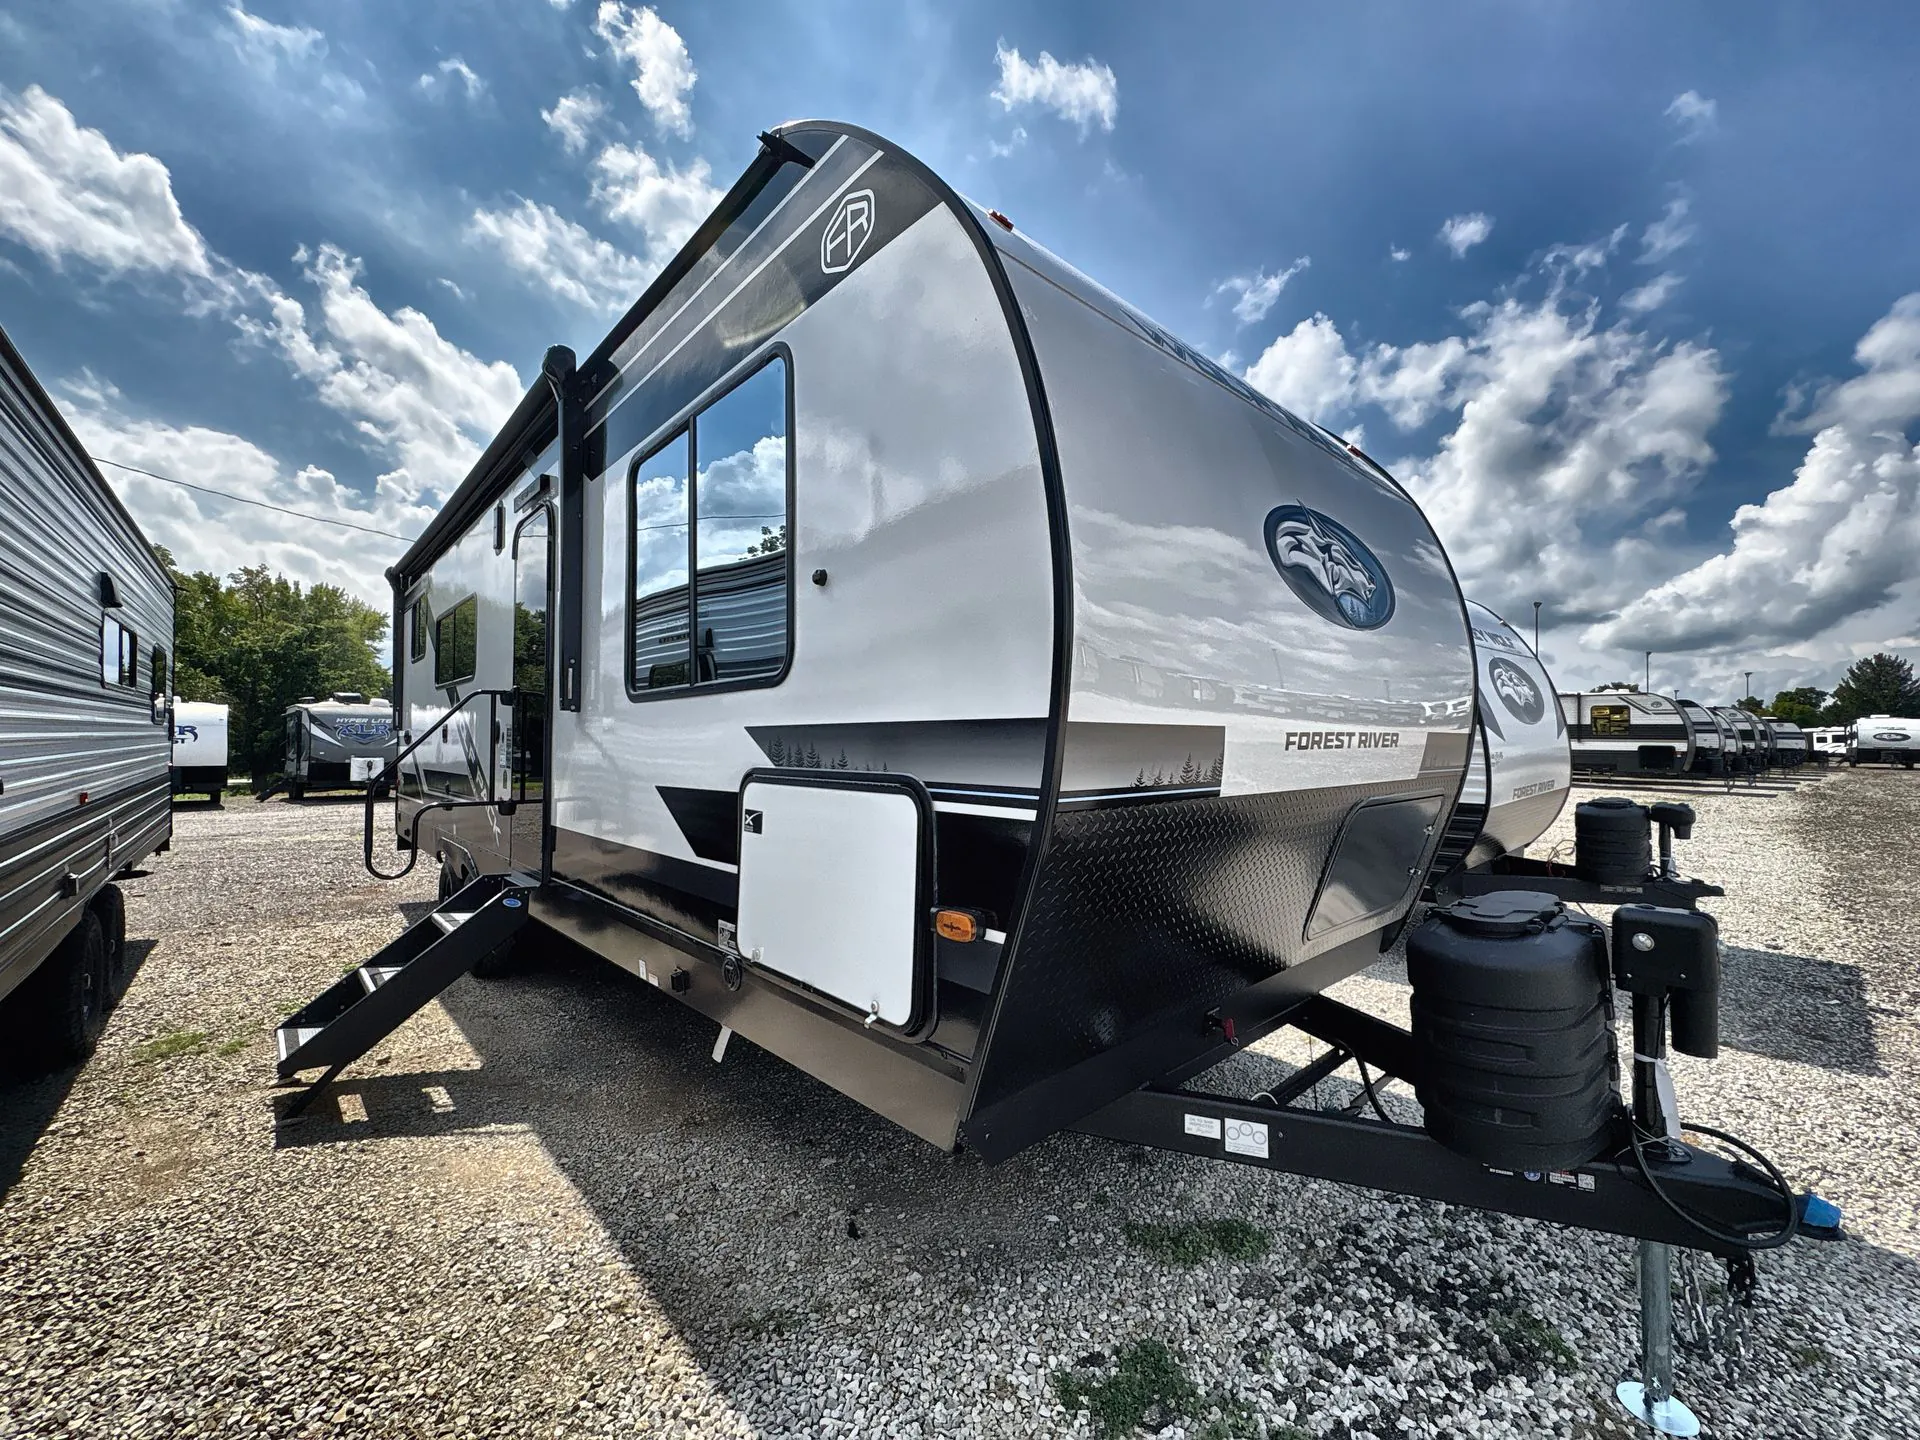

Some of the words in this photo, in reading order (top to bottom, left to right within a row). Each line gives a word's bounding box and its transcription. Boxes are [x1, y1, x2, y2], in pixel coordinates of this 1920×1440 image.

[335, 723, 391, 740] XLR
[1285, 732, 1356, 752] FOREST
[1357, 732, 1400, 749] RIVER
[1512, 784, 1539, 800] FOREST
[1538, 780, 1555, 793] RIVER
